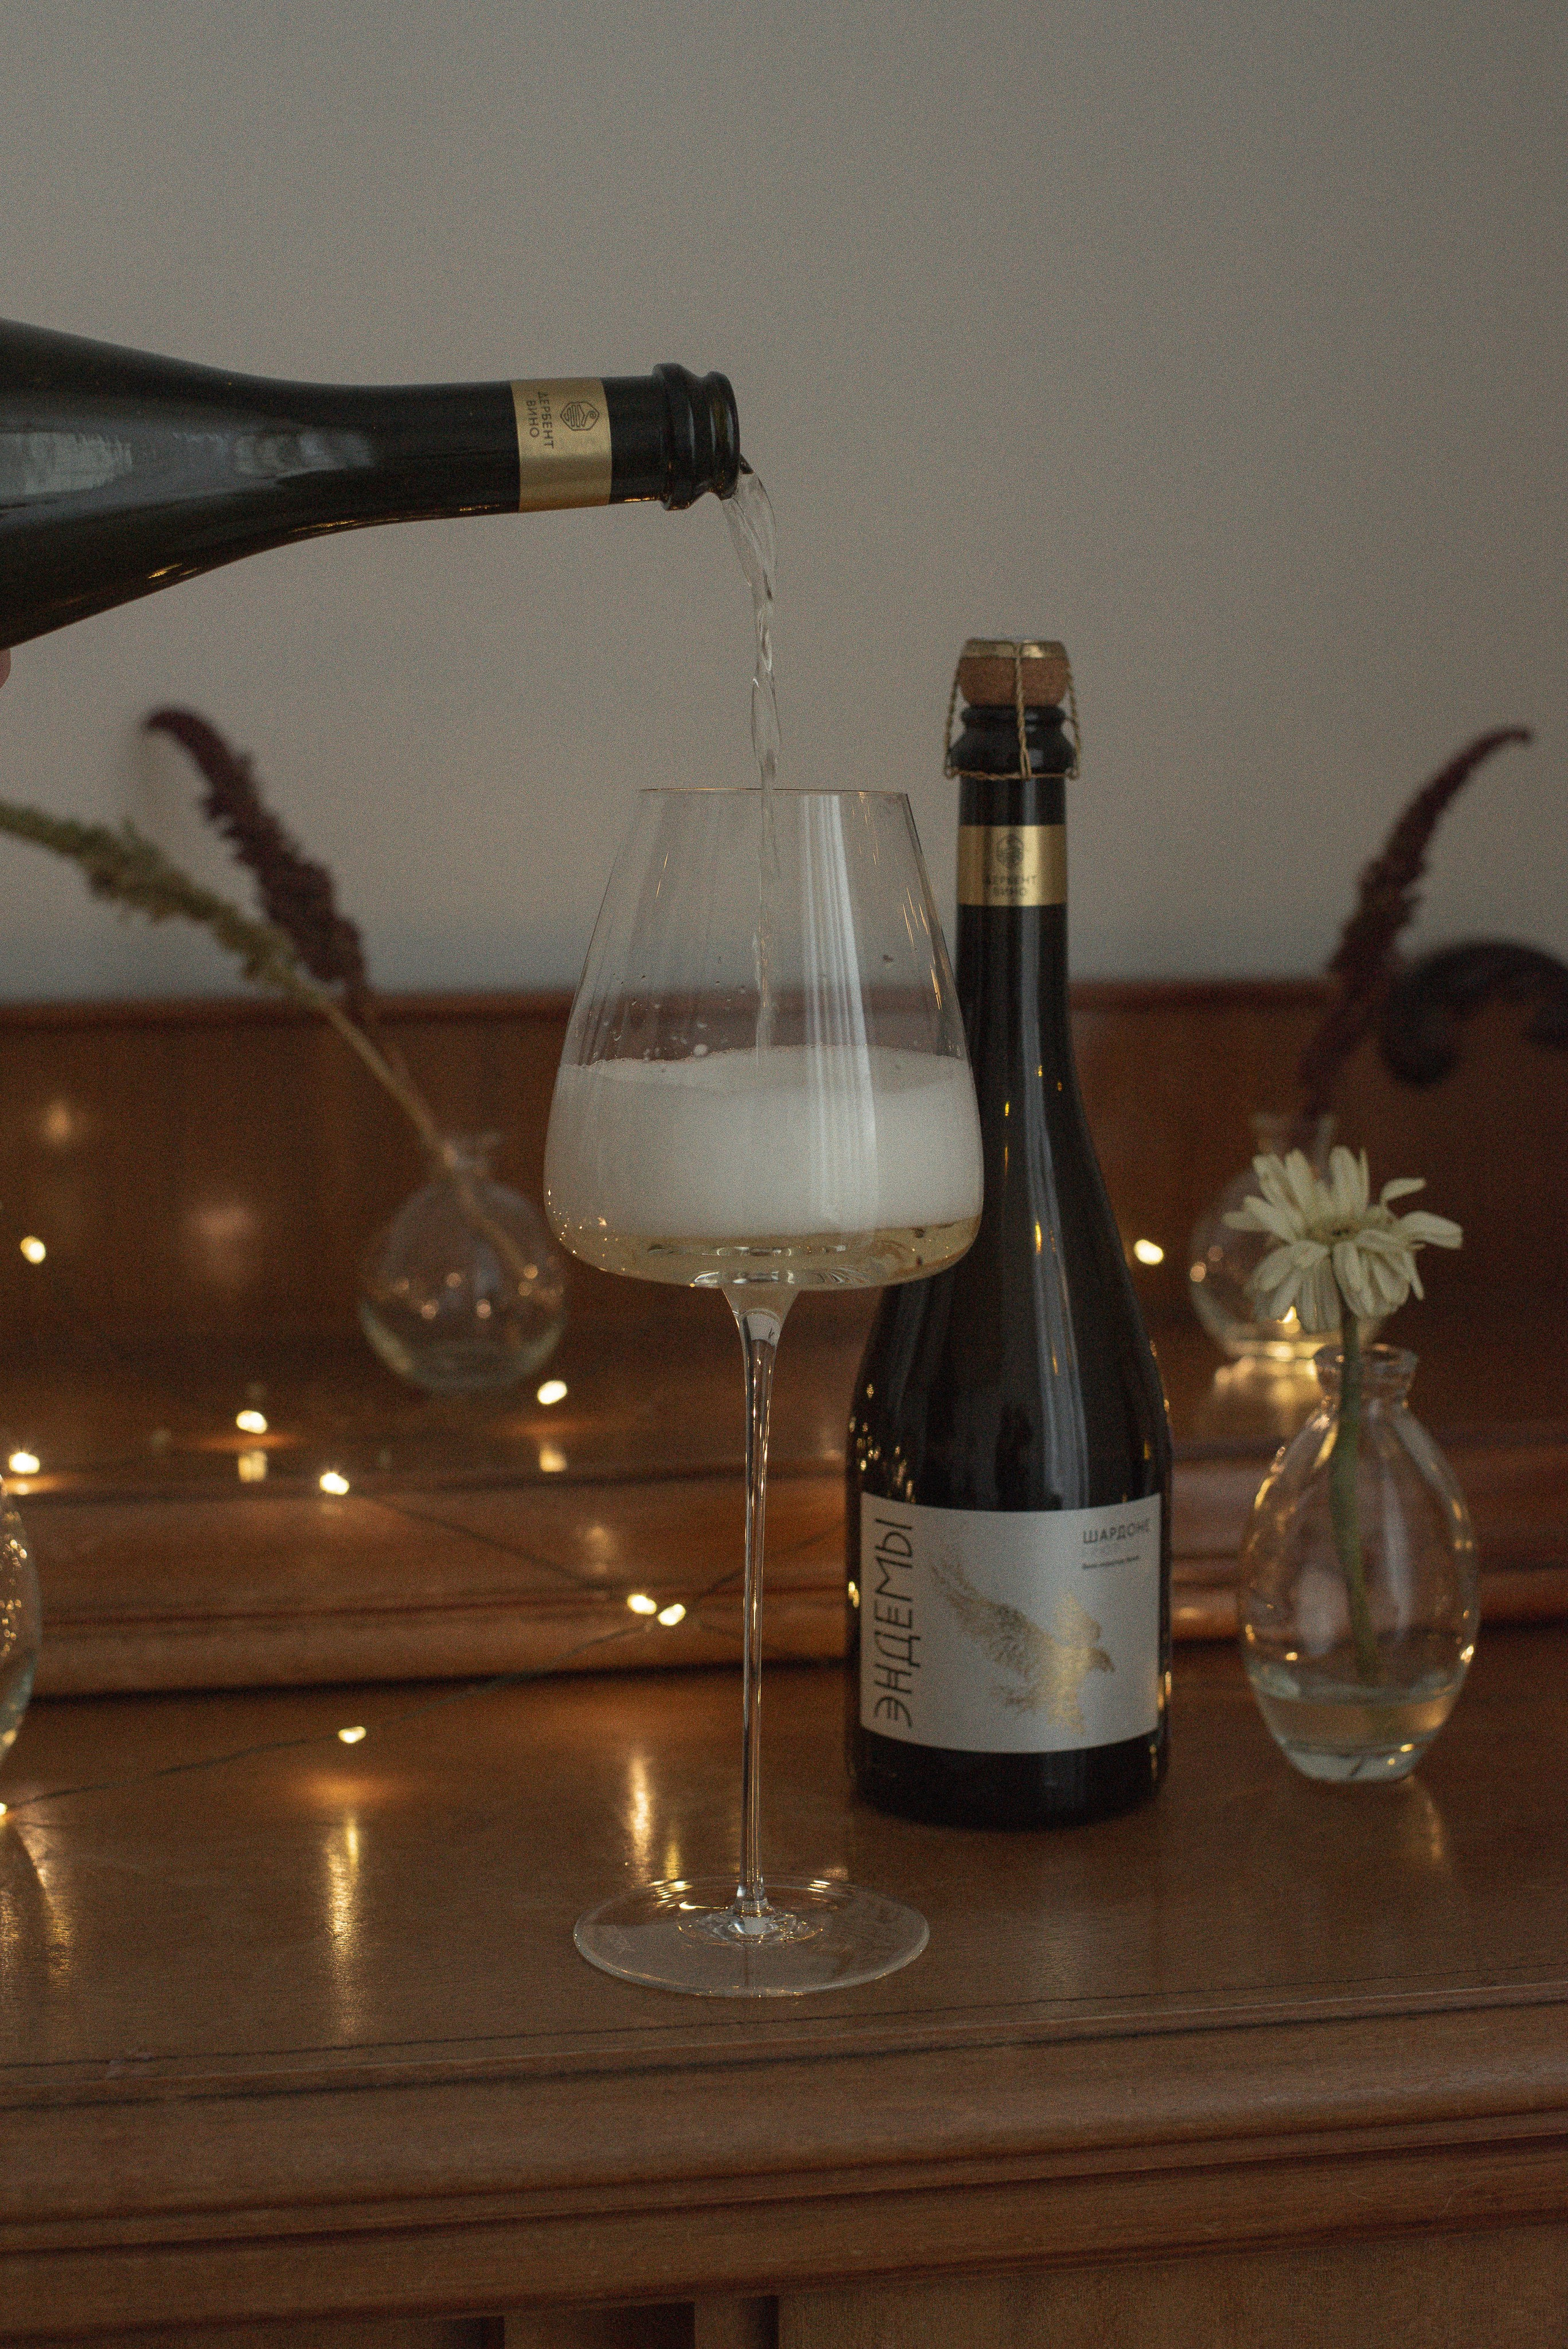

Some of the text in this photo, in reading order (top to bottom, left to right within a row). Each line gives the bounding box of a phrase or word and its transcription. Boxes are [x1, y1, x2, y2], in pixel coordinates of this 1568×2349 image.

[526, 399, 540, 438] ВИНО
[538, 392, 554, 448] ДЕРБЕНТ
[873, 1518, 921, 1729] ЭНДЕМЫ
